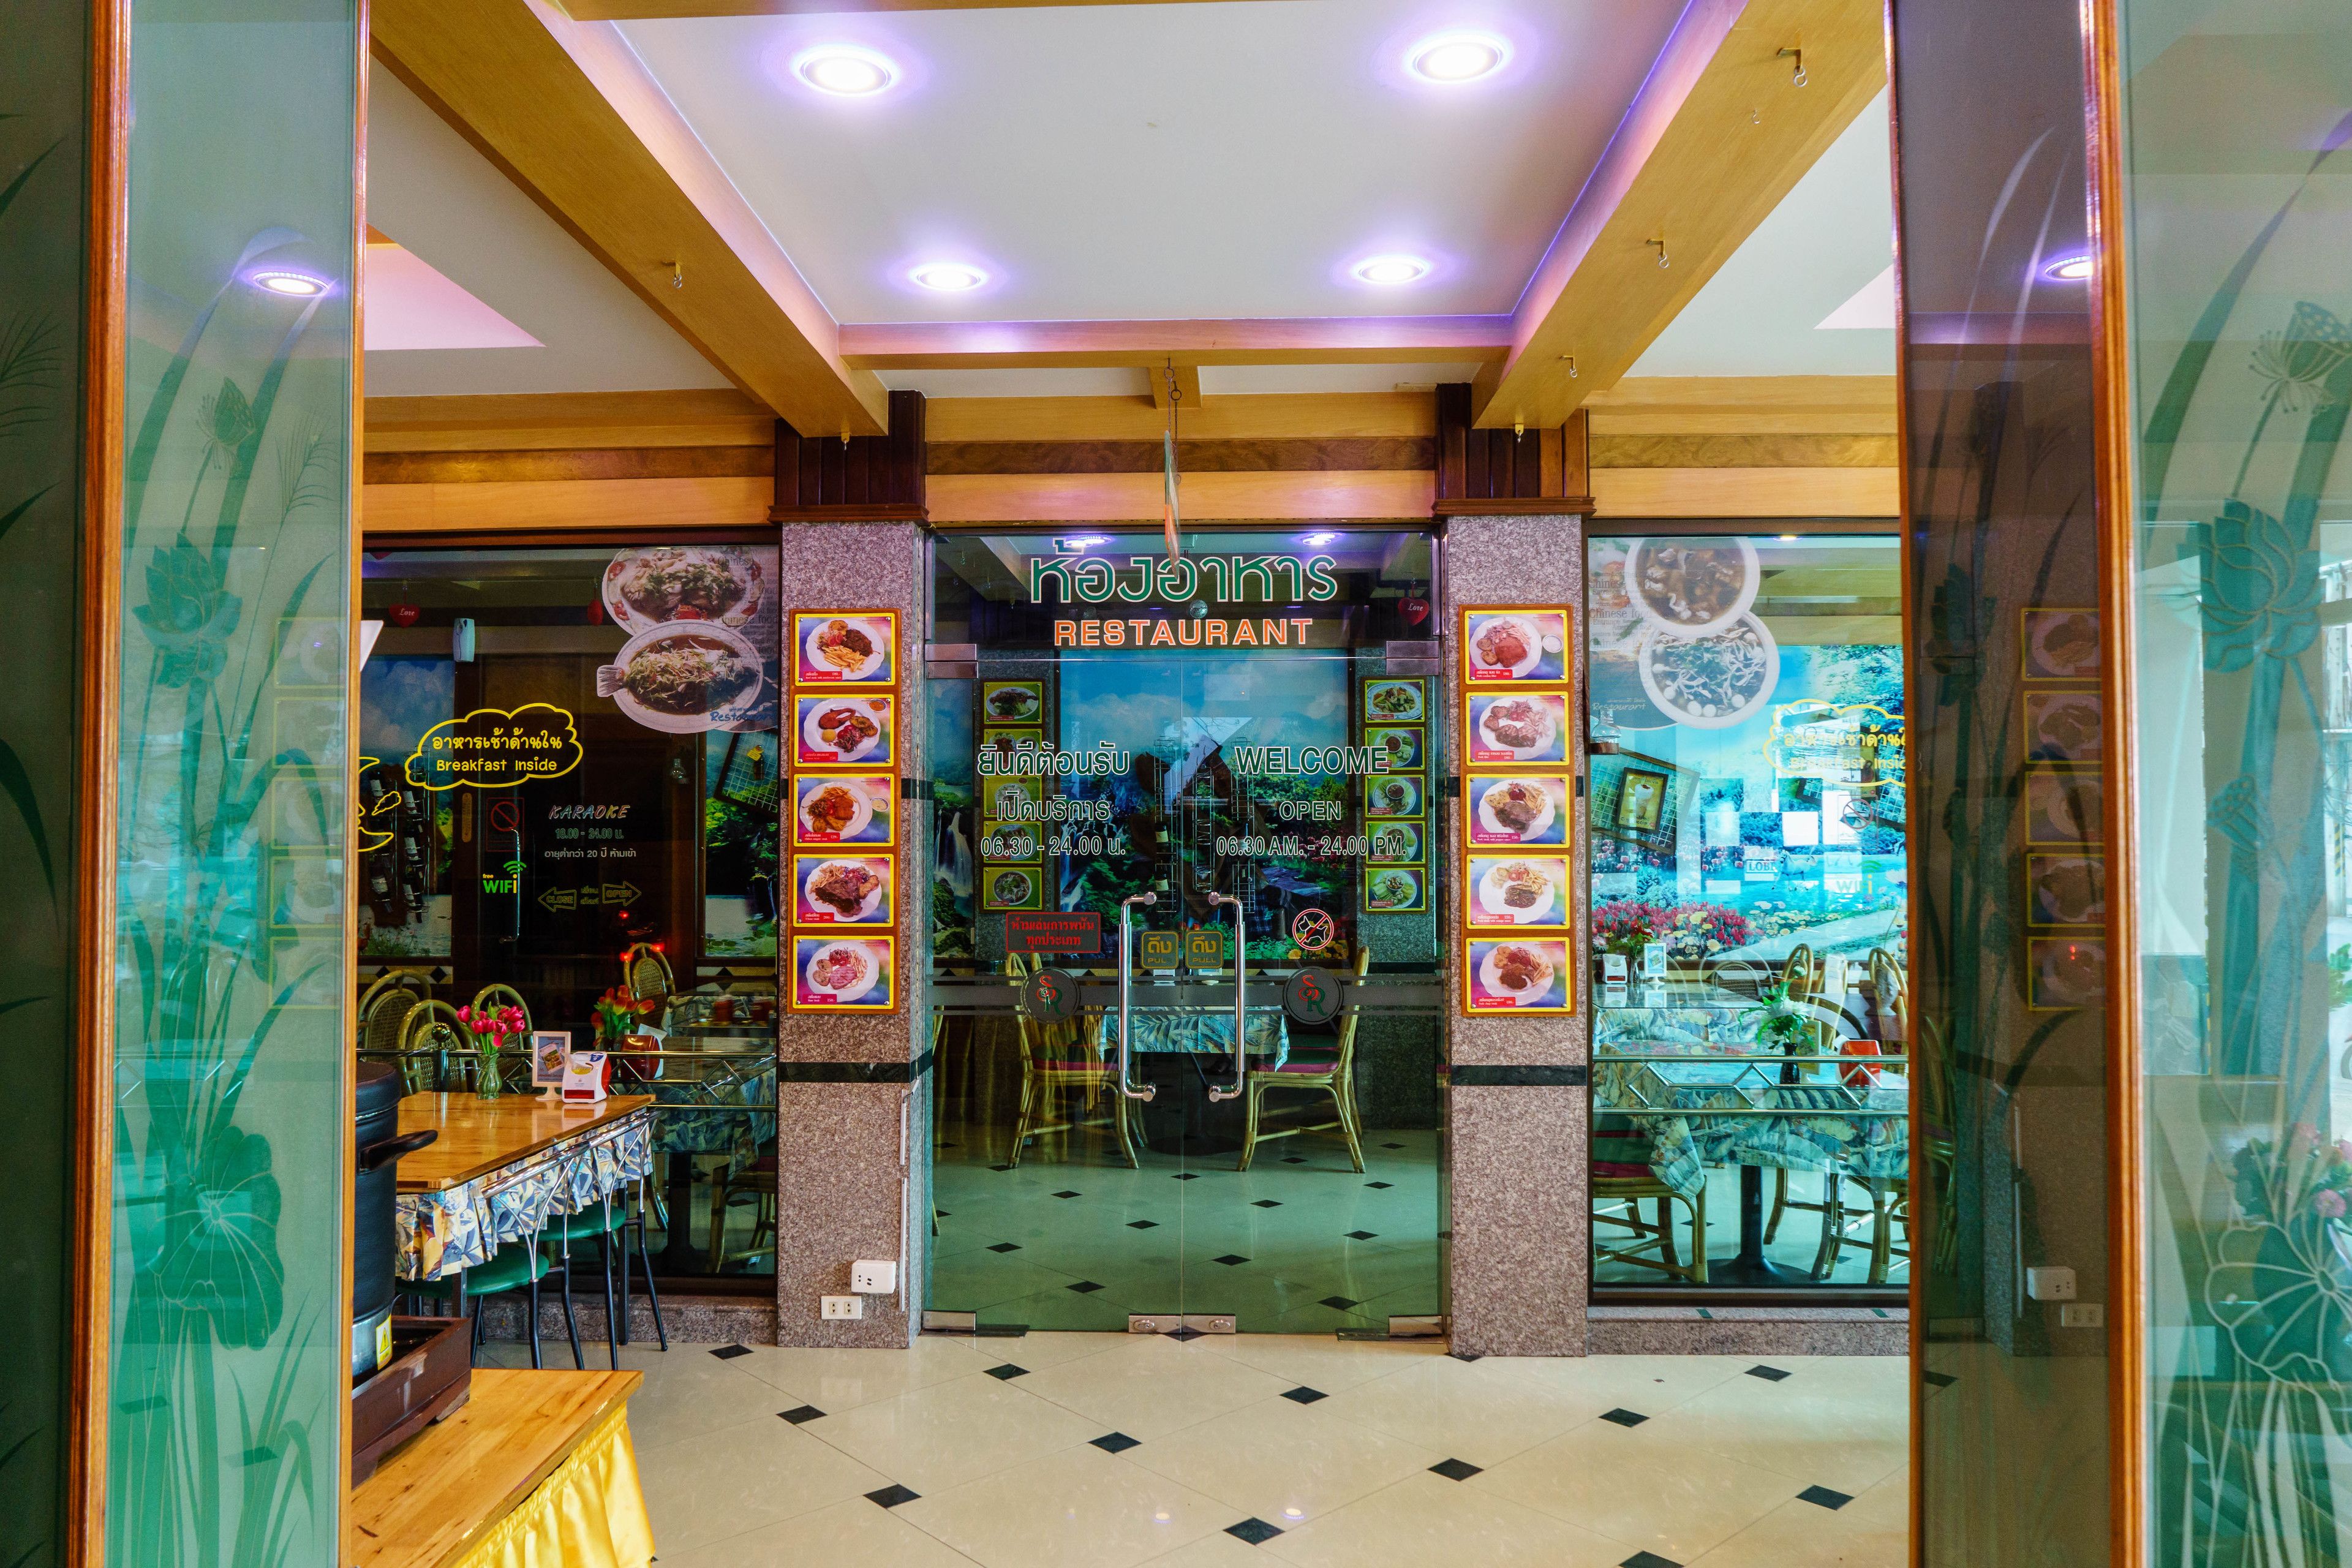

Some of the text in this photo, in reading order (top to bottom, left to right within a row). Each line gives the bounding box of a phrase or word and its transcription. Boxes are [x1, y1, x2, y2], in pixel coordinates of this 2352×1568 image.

[1031, 538, 1338, 603] ห้องอาหาร
[399, 608, 415, 616] Love
[1054, 618, 1313, 646] RESTAURANT
[1593, 701, 1646, 710] Restaurant
[432, 727, 563, 750] อาหารเช้าด้านใน
[437, 756, 557, 771] Breakfast Inside
[978, 741, 1130, 776] ยินดีต้อนรับ
[1234, 746, 1389, 775] WELCOME
[549, 805, 630, 820] KARAOKE
[997, 791, 1110, 821] เปิดบริการ
[1279, 801, 1341, 821] OPEN
[556, 828, 579, 839] 18.00
[588, 828, 612, 839] 24.00
[545, 848, 584, 860] อายุต่ำกว่า
[601, 847, 607, 858] ปี
[610, 848, 636, 858] ห้ามเข้า
[981, 836, 1034, 856] 06.30
[1049, 836, 1102, 856] 24.00
[1107, 838, 1126, 855] น.
[1216, 836, 1265, 856] 06.30
[1268, 835, 1305, 856] AM.
[1320, 835, 1369, 856] 24.00
[1373, 835, 1407, 856] PM.
[606, 889, 632, 898] OPEN
[1012, 918, 1095, 932] ห้ามเล่นการพนัน
[1026, 932, 1081, 950] ทุกประเภท
[1148, 936, 1171, 953] ดึง
[1193, 936, 1216, 953] ดึง
